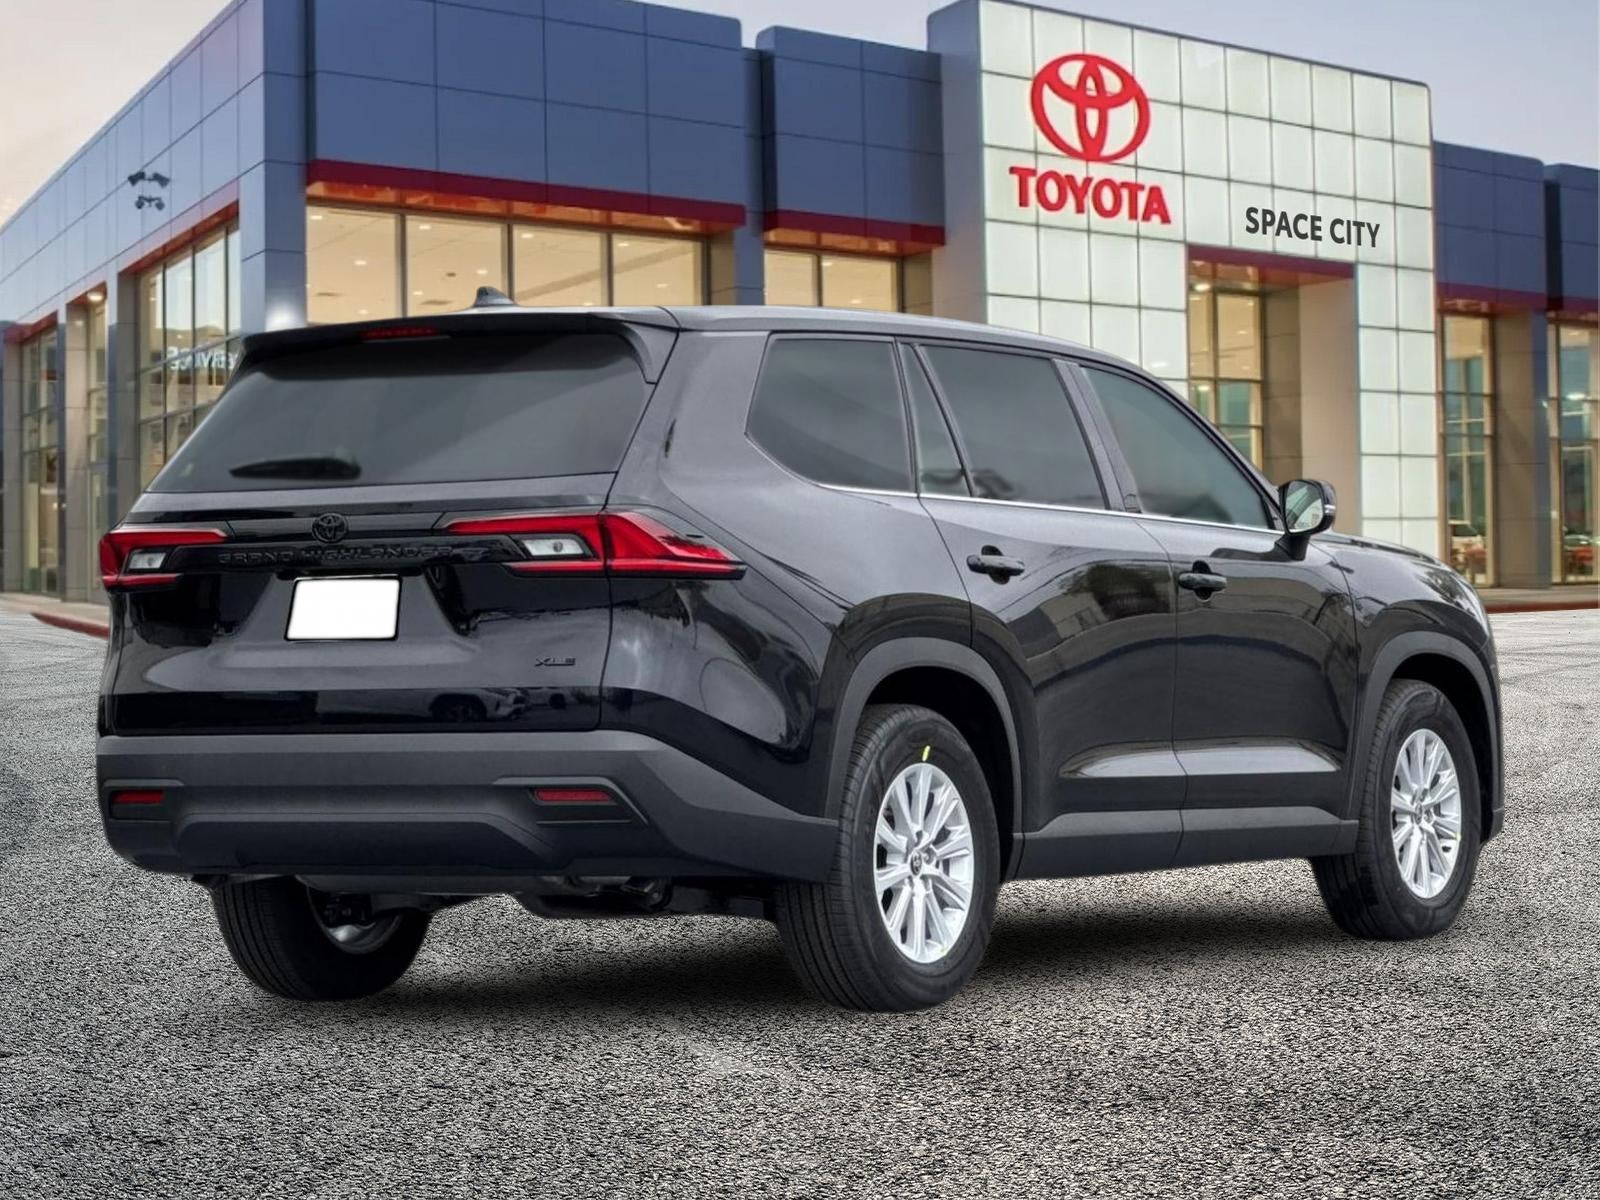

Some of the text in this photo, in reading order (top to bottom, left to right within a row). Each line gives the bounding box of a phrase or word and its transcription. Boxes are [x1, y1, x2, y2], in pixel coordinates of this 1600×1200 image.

[1009, 166, 1171, 224] TOYOTA
[1245, 206, 1381, 248] SPACE CITY
